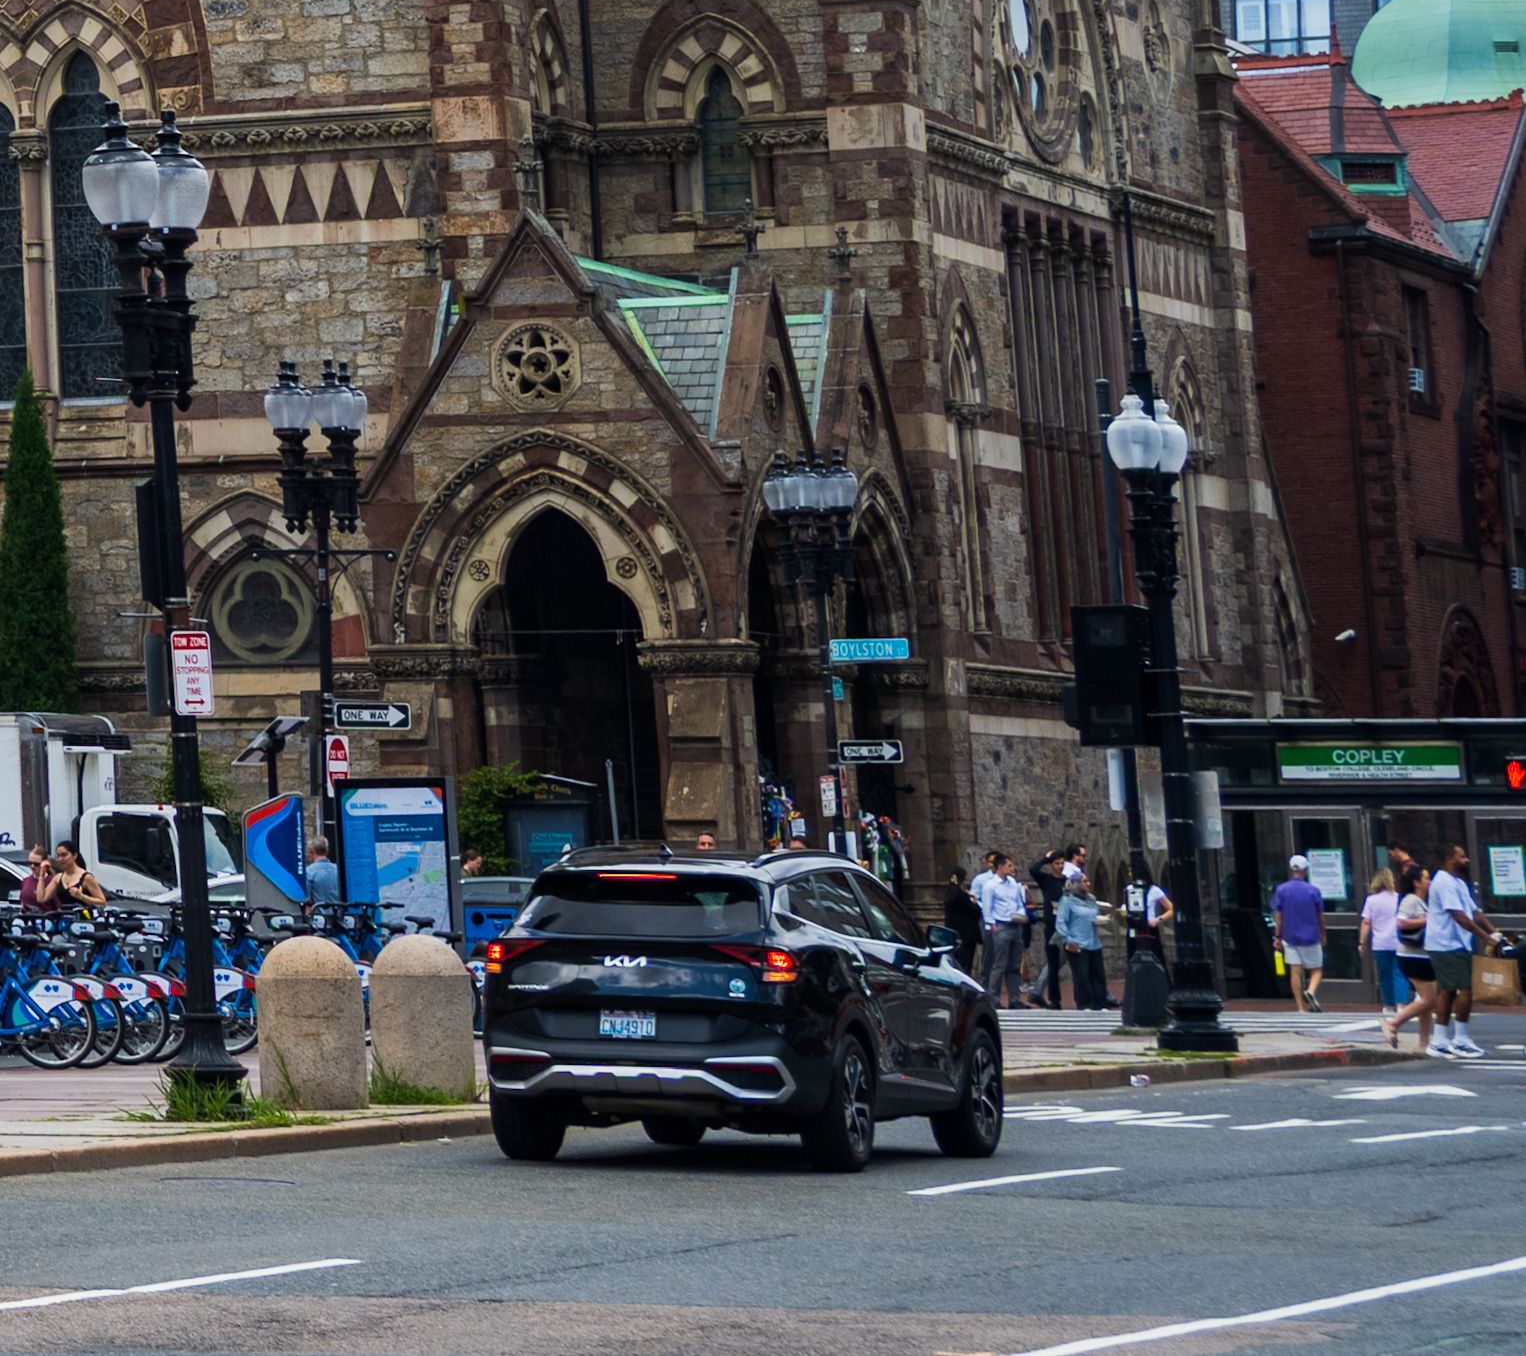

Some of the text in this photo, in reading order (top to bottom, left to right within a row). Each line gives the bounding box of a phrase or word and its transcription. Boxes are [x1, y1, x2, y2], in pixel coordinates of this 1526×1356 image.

[173, 637, 208, 647] TOW ZONE
[831, 642, 893, 657] BOYLSTON
[184, 654, 198, 664] NO
[176, 667, 209, 675] STOPPING
[186, 677, 200, 685] ANY
[186, 688, 202, 696] TIME
[344, 711, 390, 720] ONE WAY
[846, 746, 883, 756] ONE WAY
[1332, 749, 1405, 764] COPLEY
